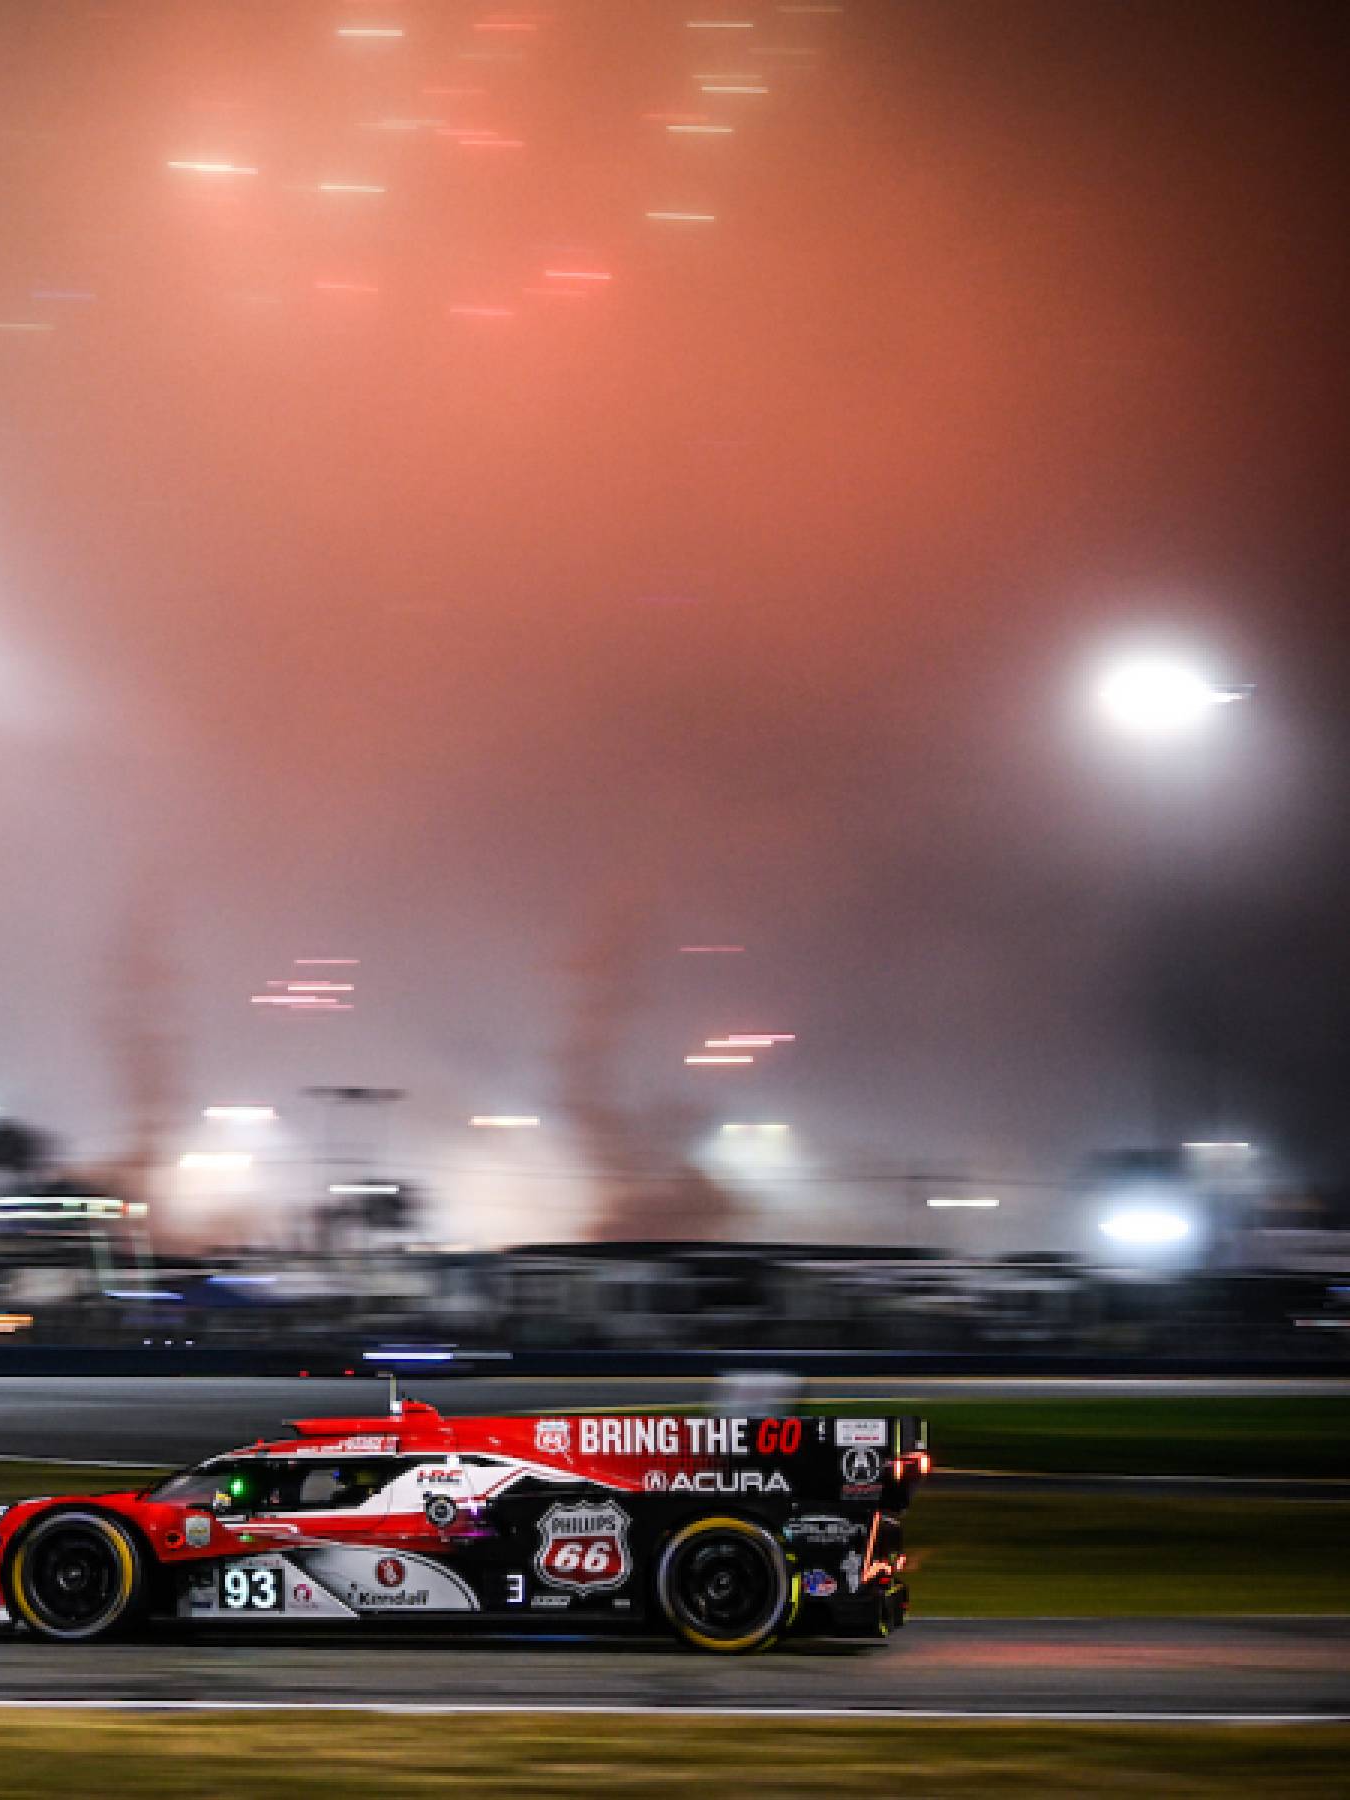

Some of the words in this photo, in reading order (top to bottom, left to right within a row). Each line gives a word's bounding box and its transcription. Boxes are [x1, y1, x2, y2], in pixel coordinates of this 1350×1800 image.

[579, 1417, 680, 1455] BRING
[684, 1417, 749, 1455] THE
[756, 1416, 802, 1455] GO
[668, 1470, 792, 1492] ACURA
[551, 1514, 616, 1534] PHILLIPS
[553, 1541, 612, 1573] 66
[223, 1570, 277, 1609] 93
[359, 1589, 430, 1606] Kendall
[506, 1574, 524, 1603] 3
